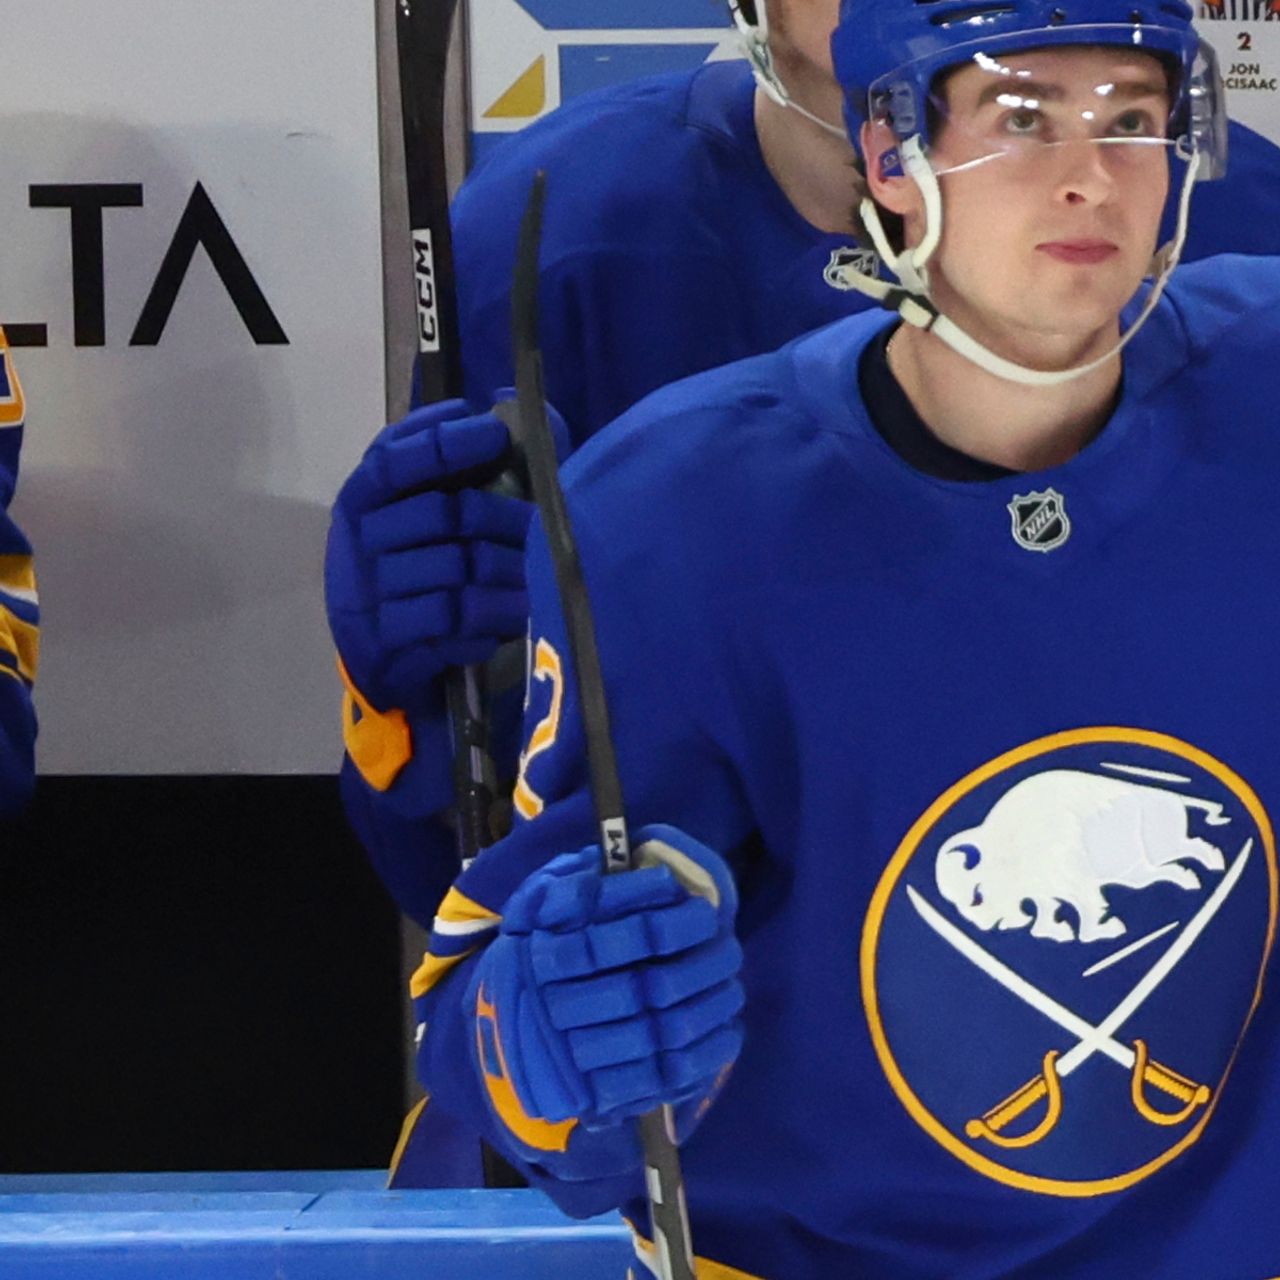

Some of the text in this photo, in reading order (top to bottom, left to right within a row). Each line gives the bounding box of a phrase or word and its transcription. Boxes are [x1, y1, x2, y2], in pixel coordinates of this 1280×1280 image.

[1236, 31, 1252, 52] 2
[1228, 64, 1261, 76] JON
[1222, 78, 1278, 91] CISAAC
[413, 239, 436, 342] CCM
[1025, 504, 1056, 540] NHL
